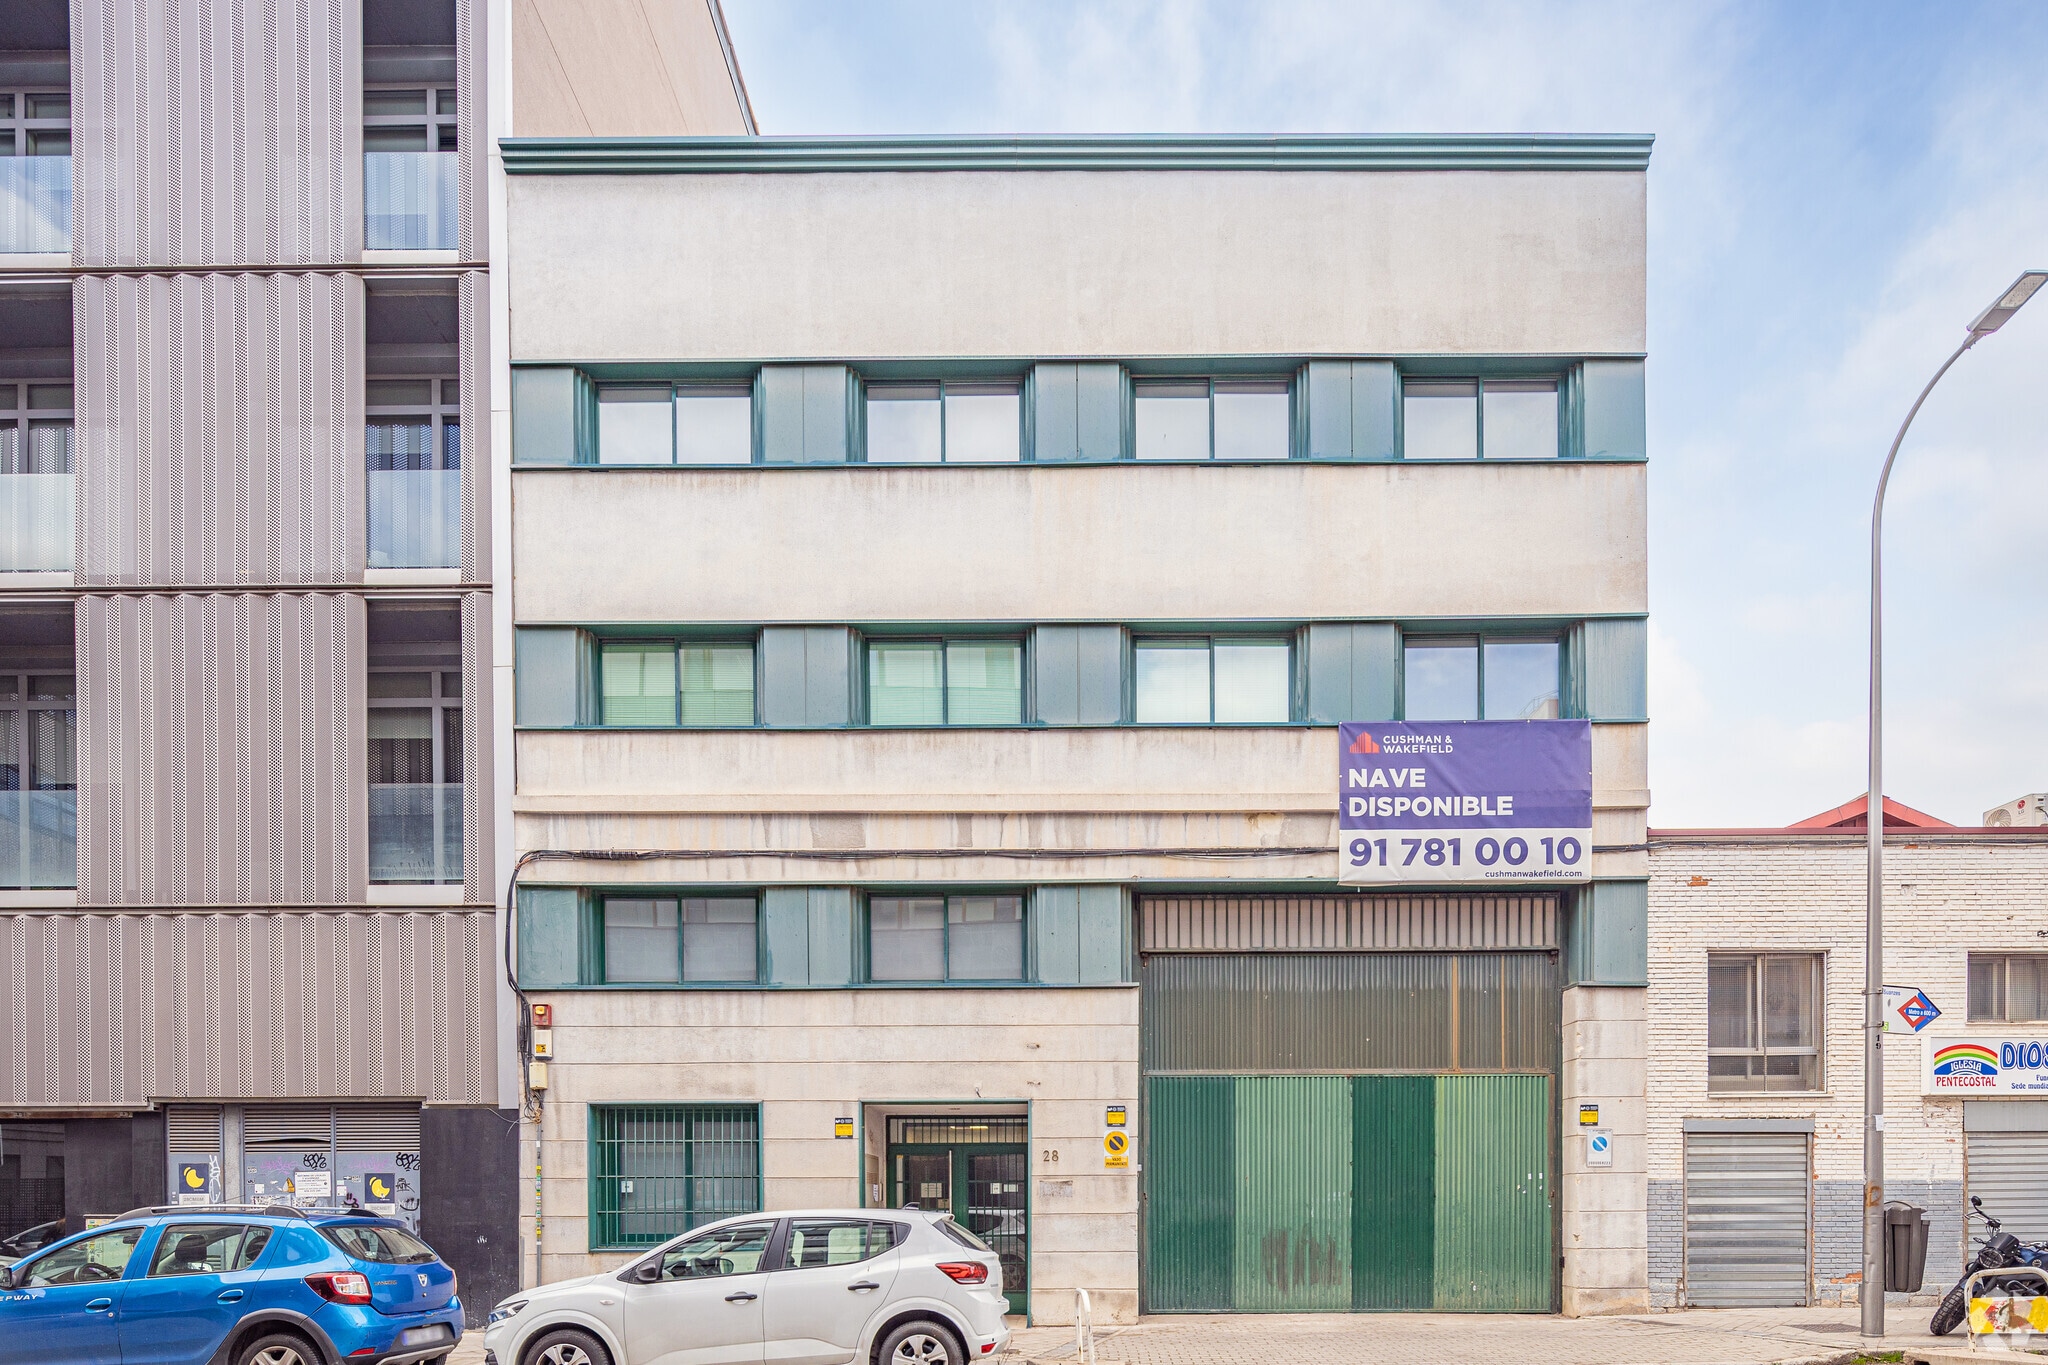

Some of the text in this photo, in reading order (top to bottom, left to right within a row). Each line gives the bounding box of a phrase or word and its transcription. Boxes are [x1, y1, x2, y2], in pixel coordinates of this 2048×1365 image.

[1383, 735, 1453, 744] CUSHMAN &
[1383, 745, 1453, 754] WAKEFIELD
[1349, 768, 1426, 788] NAVE
[1349, 796, 1513, 817] DISPONIBLE
[1349, 836, 1582, 866] 91 781 00 10
[1485, 870, 1582, 878] cushmanwakefield.com
[1950, 1060, 1982, 1072] IGLESIA
[1936, 1076, 1997, 1087] PENTECOSTAL
[1043, 1150, 1059, 1162] 28
